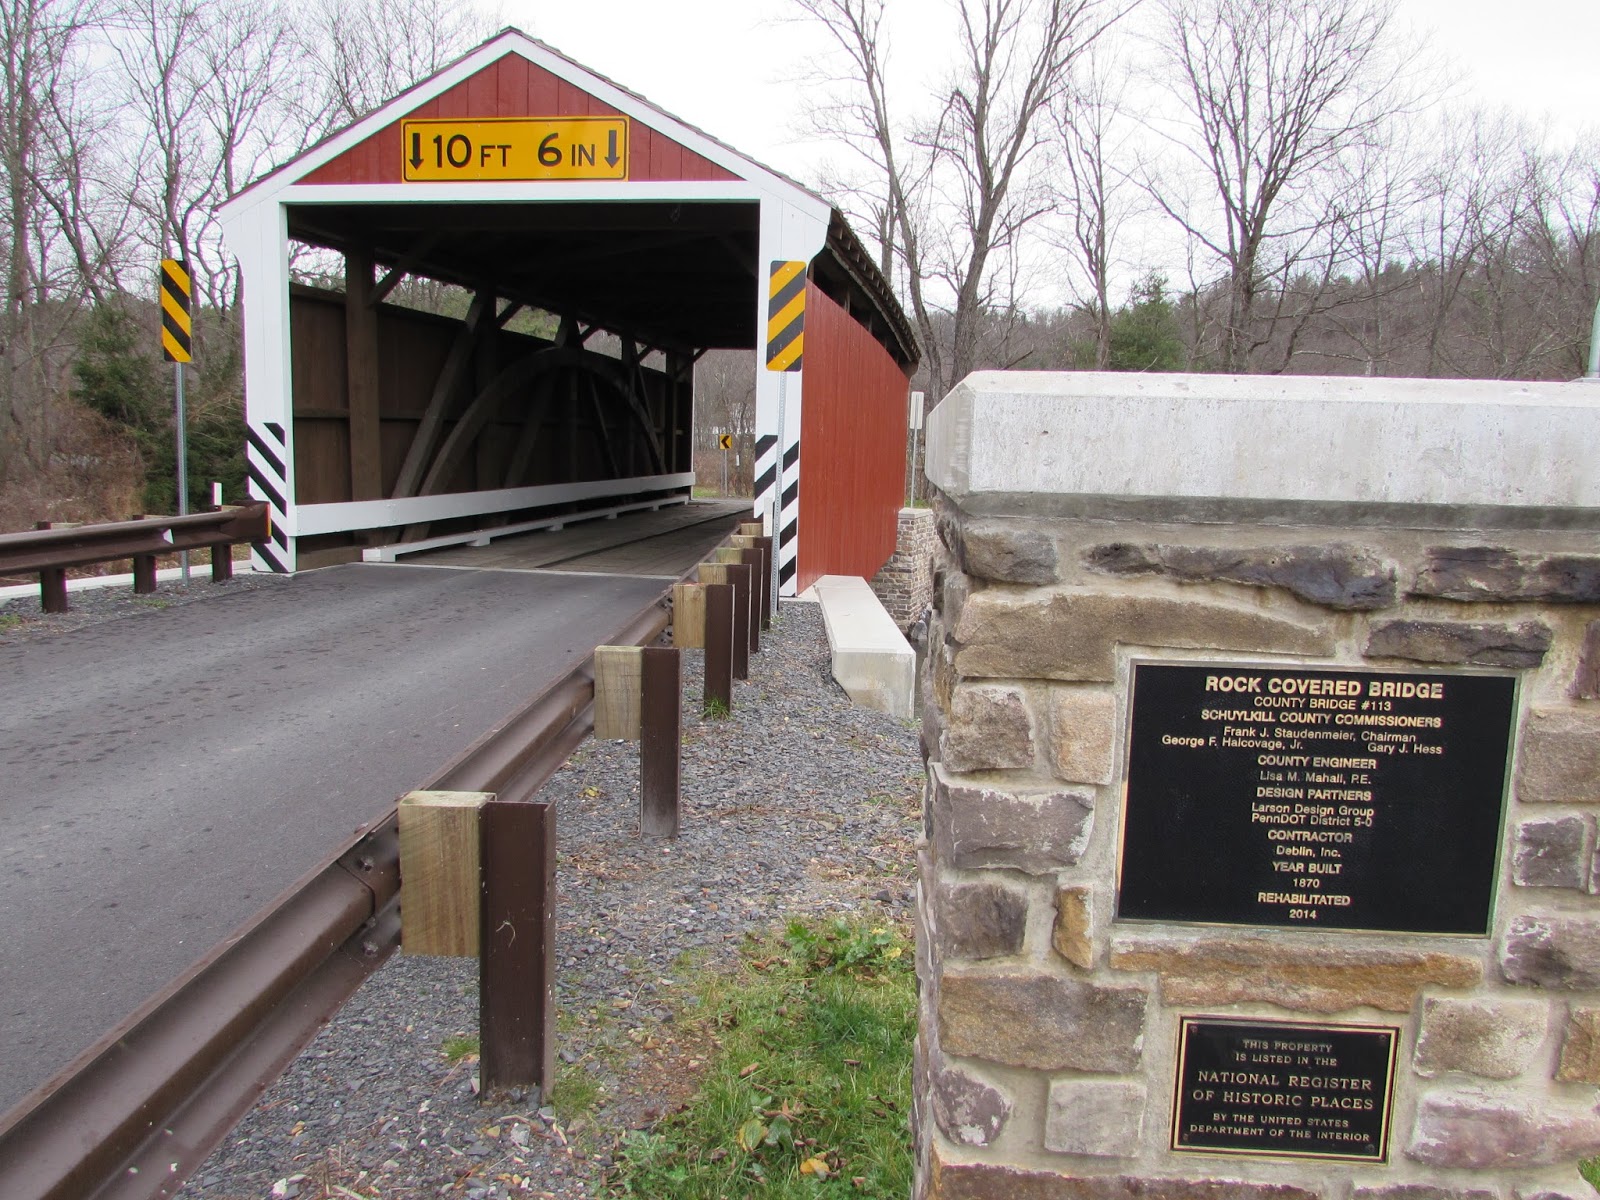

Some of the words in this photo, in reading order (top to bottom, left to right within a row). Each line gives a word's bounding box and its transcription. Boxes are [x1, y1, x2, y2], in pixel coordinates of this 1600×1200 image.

[433, 134, 472, 168] 10
[480, 145, 512, 167] FT
[537, 132, 563, 167] 6
[571, 144, 595, 167] IN
[1205, 676, 1262, 693] ROCK
[1267, 678, 1361, 696] COVERED
[1368, 681, 1444, 699] BRIDGE
[1254, 696, 1306, 708] COUNTY
[1309, 698, 1356, 710] BRIDGE
[1361, 700, 1392, 711] #113
[1201, 709, 1276, 722] SCHUYLKILL
[1279, 712, 1332, 724] COUNTY
[1335, 714, 1442, 728] COMMISSIONERS
[1223, 726, 1256, 737] Frank
[1260, 727, 1269, 738] J.
[1274, 727, 1356, 741] Staudenmeier,
[1361, 731, 1416, 743] Chairman
[1161, 735, 1204, 748] George
[1208, 736, 1217, 747] F.
[1222, 737, 1285, 750] Halcovage,
[1290, 739, 1303, 750] Jr.
[1367, 743, 1395, 755] Gary
[1399, 744, 1408, 754] J.
[1413, 744, 1442, 754] Hess
[1258, 755, 1309, 767] COUNTY
[1312, 757, 1377, 769] ENGINEER
[1260, 771, 1283, 781] Lisa
[1287, 772, 1300, 782] M.
[1351, 774, 1372, 784] P.E.
[1256, 787, 1303, 799] DESIGN
[1307, 789, 1372, 801] PARTNERS
[1251, 802, 1290, 813] Larson
[1294, 804, 1334, 817] Design
[1339, 806, 1374, 818] Group
[1251, 813, 1306, 824] PennDOT
[1310, 815, 1350, 826] District
[1354, 817, 1373, 827] 5-0
[1267, 829, 1353, 843] CONTRACTOR
[1320, 847, 1341, 857] Inc.
[1272, 861, 1304, 873] YEAR
[1308, 863, 1343, 874] BUILT
[1293, 878, 1320, 888] 1870
[1257, 892, 1351, 906] REHABILITATED
[1289, 909, 1317, 919] 2014
[1242, 1039, 1269, 1049] THIS
[1274, 1041, 1333, 1053] PROPERTY
[1235, 1052, 1247, 1061] IS
[1252, 1053, 1292, 1064] LISTED
[1297, 1056, 1309, 1065] IN
[1315, 1057, 1337, 1066] THE
[1198, 1071, 1280, 1085] NATIONAL
[1288, 1075, 1372, 1090] REGISTER
[1193, 1090, 1214, 1101] OF
[1224, 1091, 1302, 1106] HISTORIC
[1311, 1096, 1374, 1110] PLACES
[1213, 1113, 1227, 1121] BY
[1233, 1114, 1255, 1123] THE
[1260, 1115, 1301, 1125] UNITED
[1307, 1118, 1349, 1128] STATES
[1189, 1124, 1264, 1136] DEPARTMENT
[1269, 1128, 1284, 1137] OF
[1289, 1129, 1311, 1138] THE
[1317, 1131, 1370, 1142] INTERIOR
